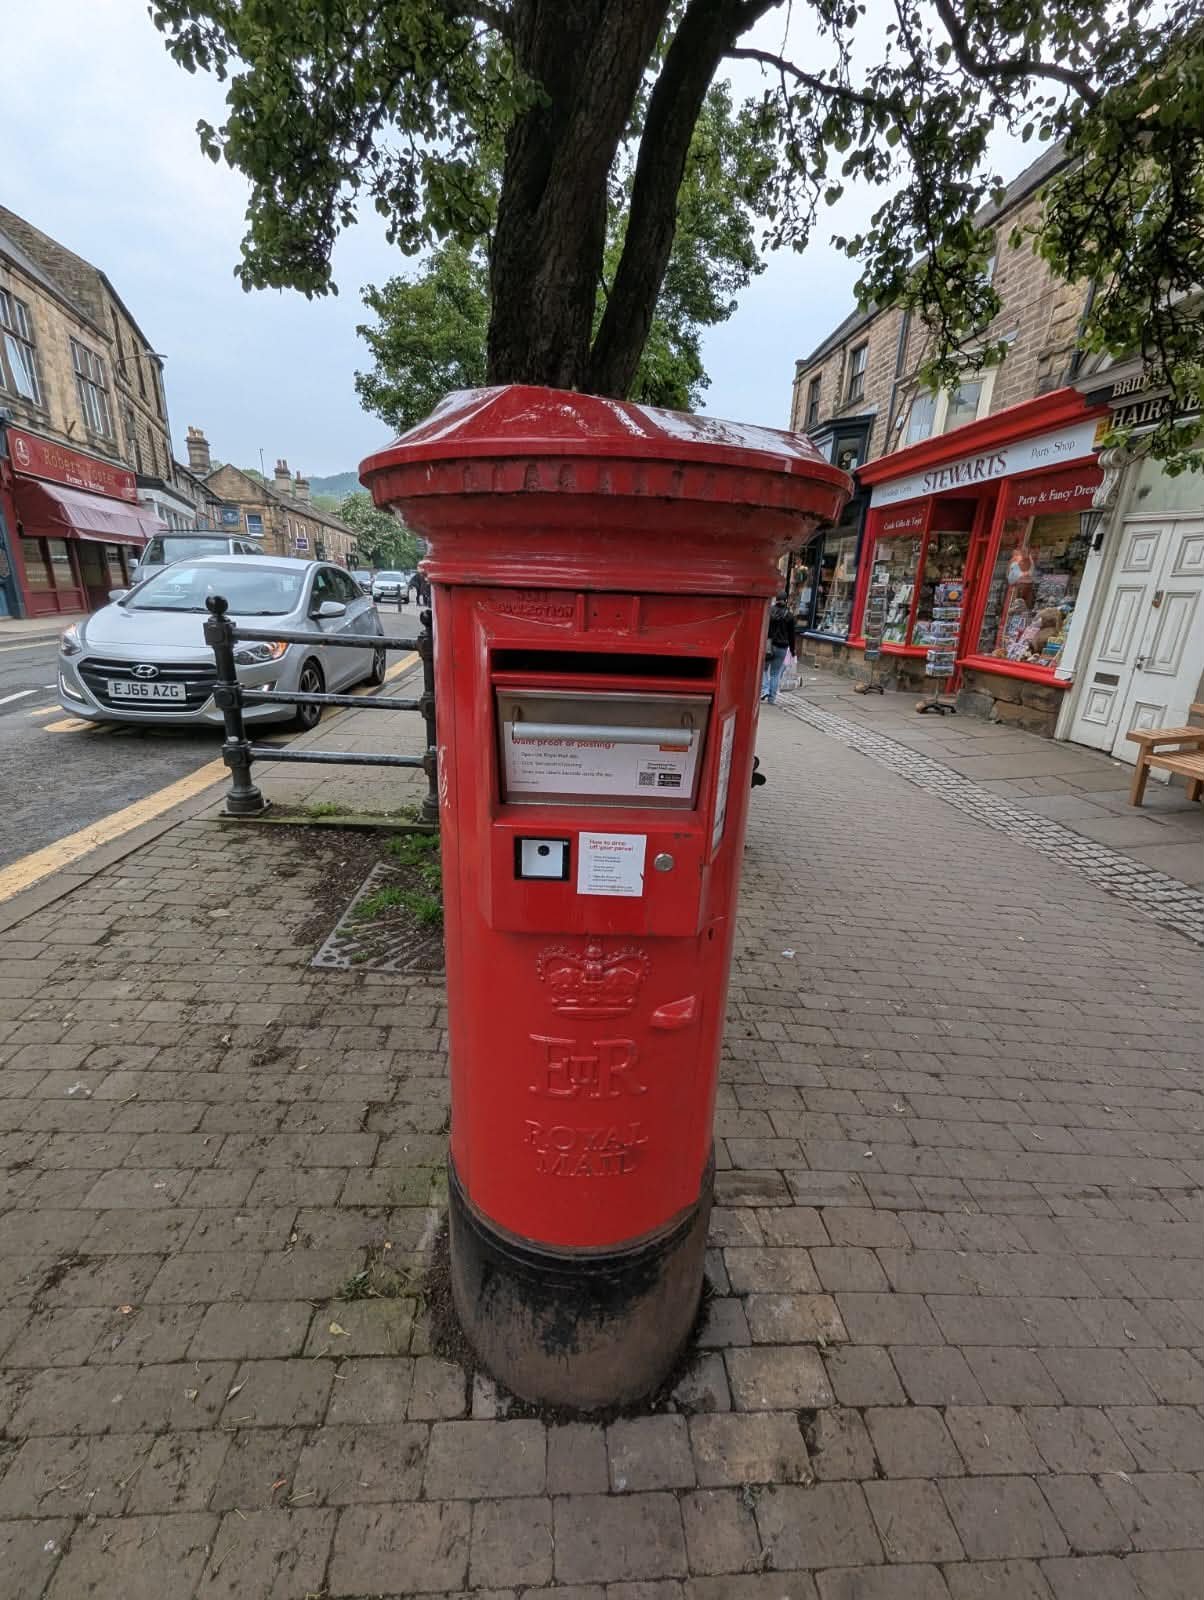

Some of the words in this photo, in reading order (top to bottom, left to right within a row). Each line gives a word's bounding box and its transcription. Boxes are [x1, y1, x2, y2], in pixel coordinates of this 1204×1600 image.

[1111, 399, 1162, 429] HAIR
[1031, 447, 1049, 458] Party
[1054, 441, 1075, 452] Shop
[922, 451, 1009, 491] STEWARTS
[1018, 495, 1037, 506] Party
[1038, 492, 1047, 502] &
[1049, 489, 1072, 501] Fancy
[1074, 485, 1098, 496] Dress
[113, 682, 149, 696] EJ66
[153, 684, 179, 697] AZG
[537, 738, 563, 748] proof
[565, 739, 575, 747] of
[525, 1119, 649, 1152] ROYAL
[536, 1149, 635, 1177] MAIL
